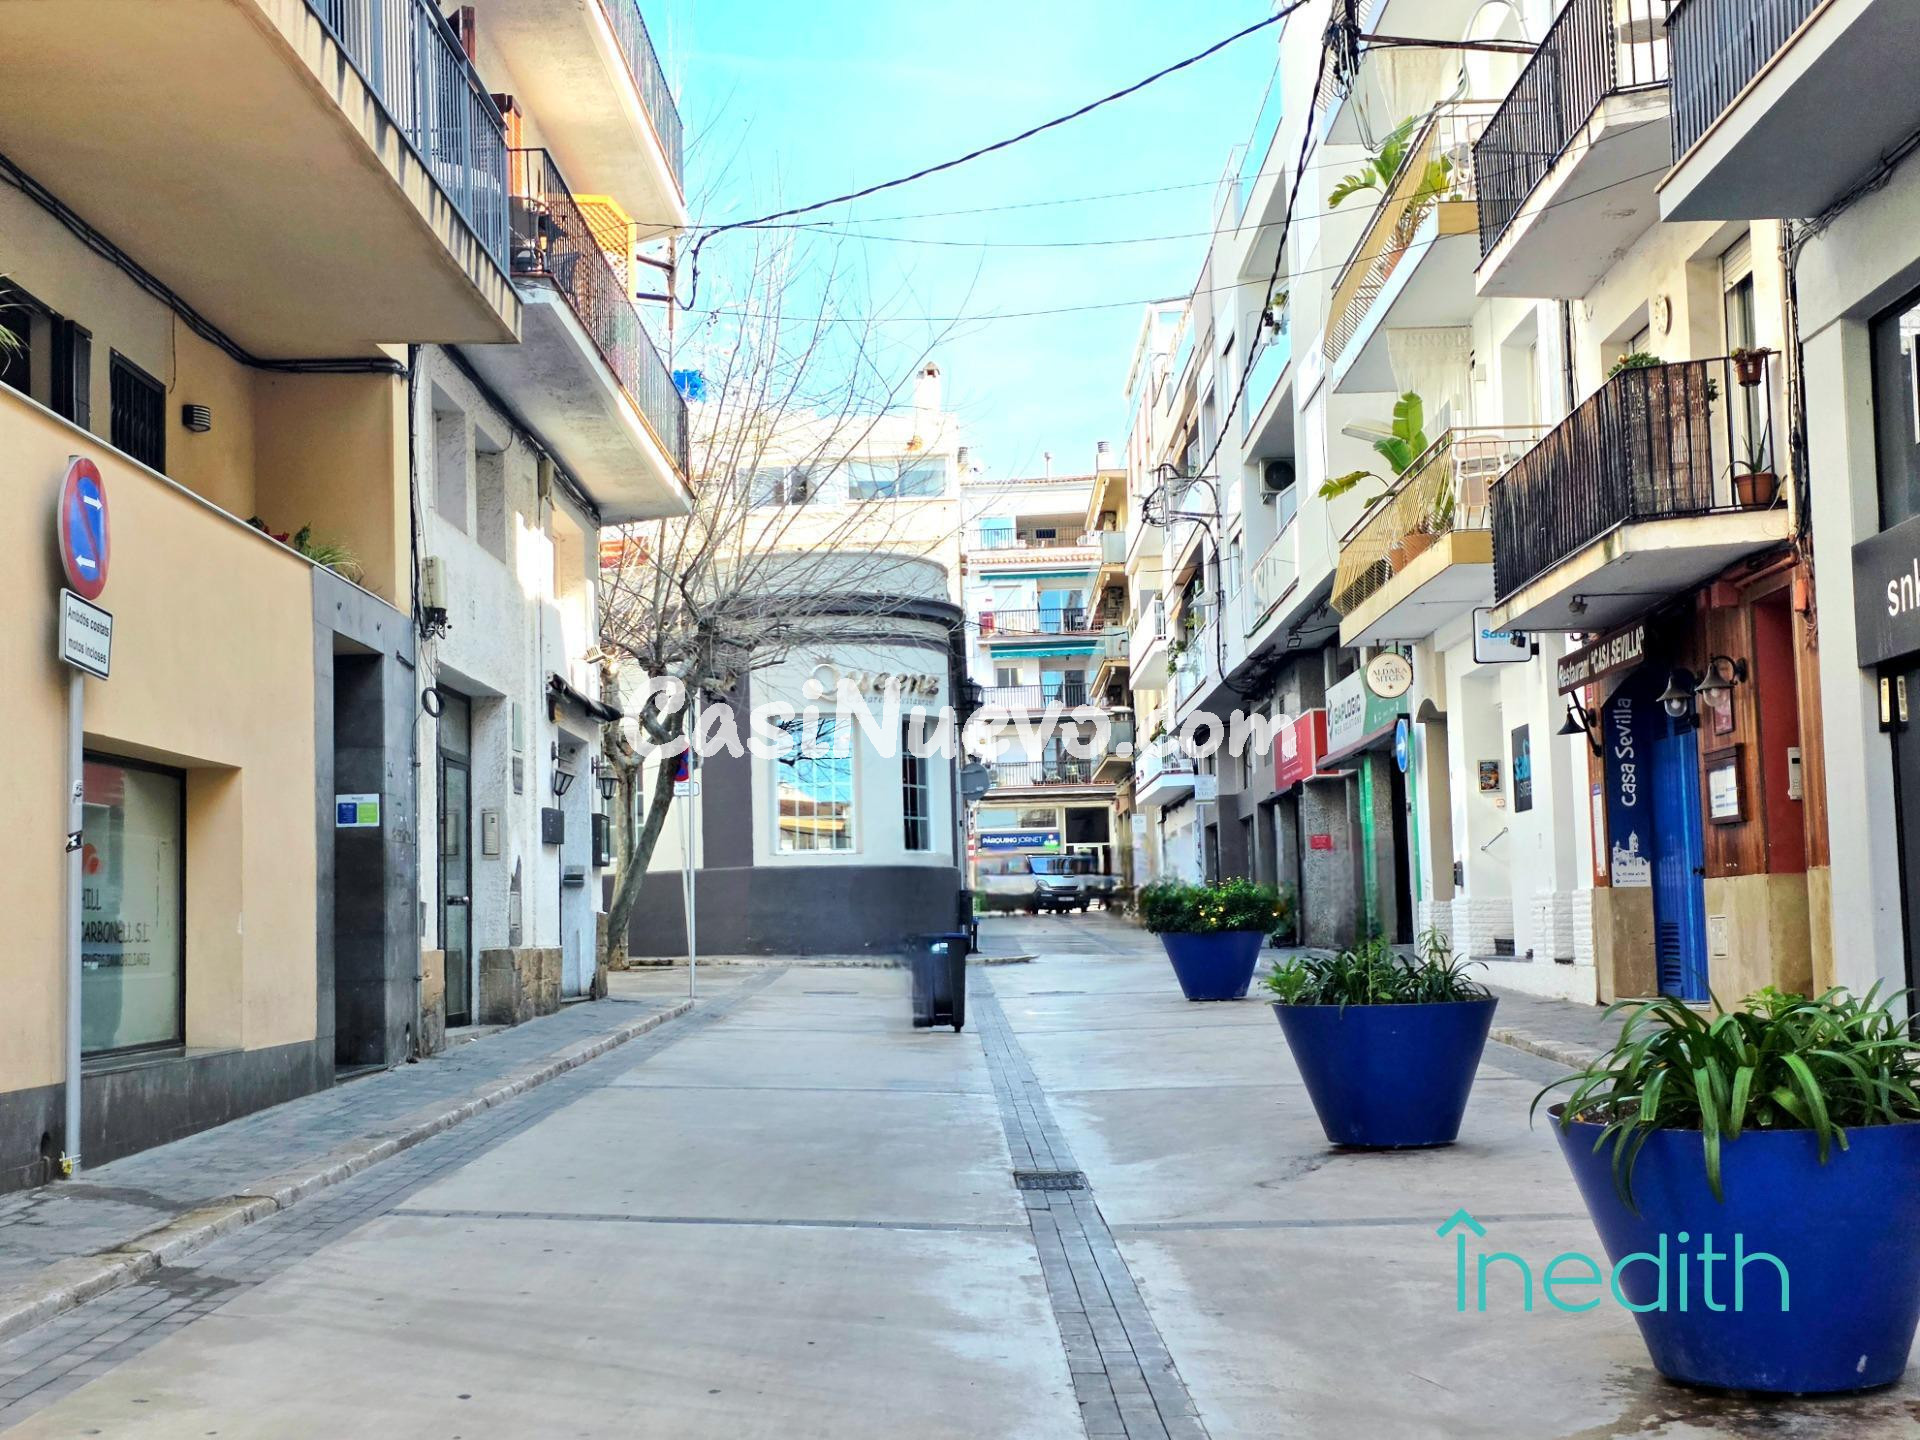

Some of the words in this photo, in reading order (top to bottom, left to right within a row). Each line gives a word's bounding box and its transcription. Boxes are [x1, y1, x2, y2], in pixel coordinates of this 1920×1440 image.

[90, 619, 110, 637] costats
[68, 638, 84, 655] motos
[85, 642, 107, 664] incloses
[1375, 674, 1406, 683] SITGES
[1613, 697, 1635, 759] Sevilla
[1018, 836, 1043, 844] JORNET
